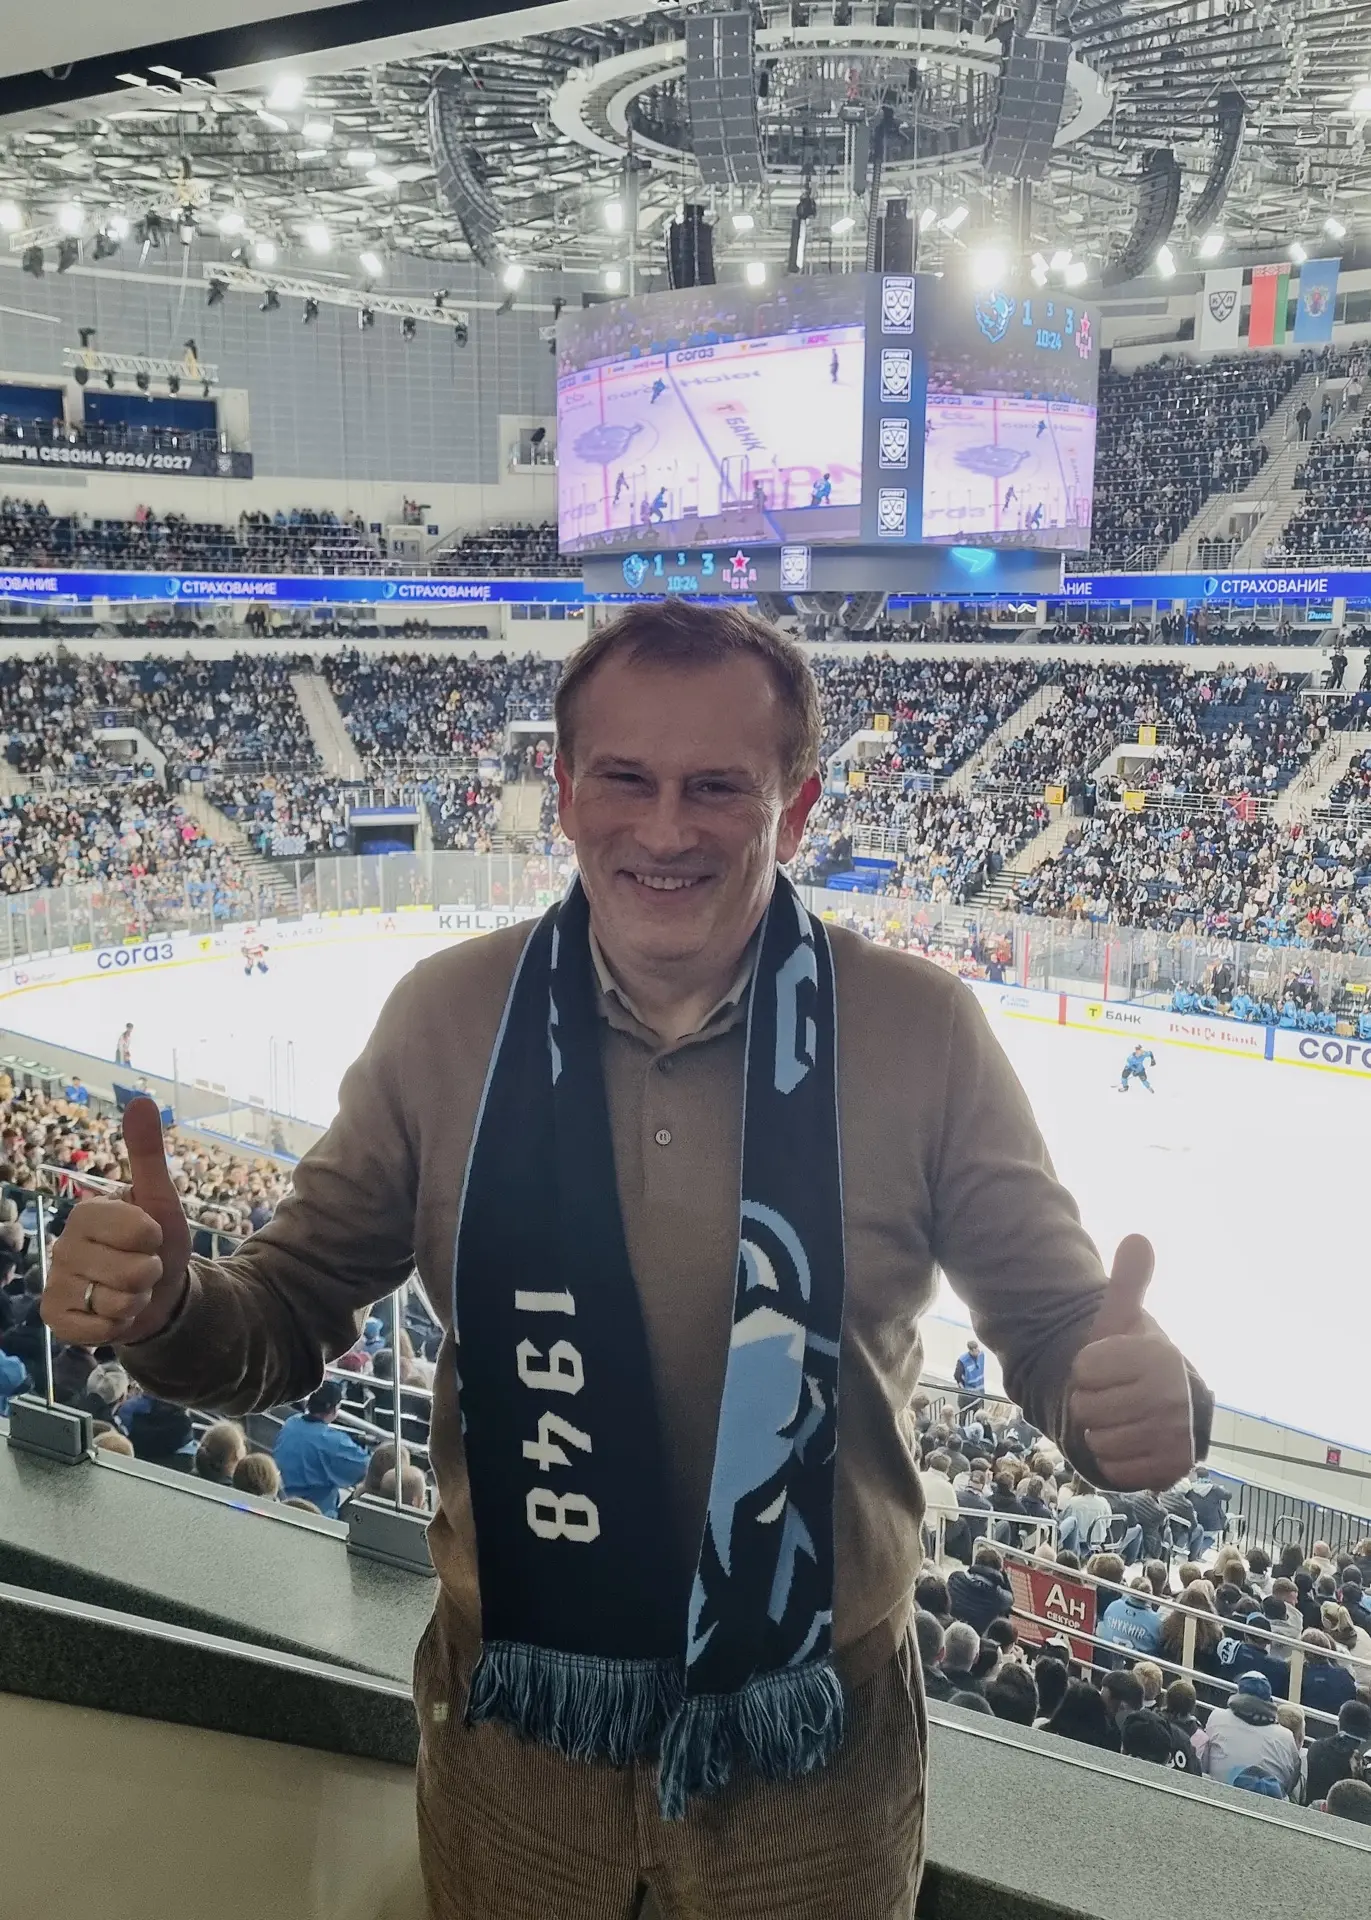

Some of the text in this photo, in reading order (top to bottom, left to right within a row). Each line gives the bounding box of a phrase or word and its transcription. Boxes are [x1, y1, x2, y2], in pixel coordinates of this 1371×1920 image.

[1022, 299, 1033, 326] 1
[1065, 307, 1075, 335] 3
[40, 446, 103, 465] СЕЗОНА
[105, 451, 192, 470] 2026/2027
[653, 552, 714, 576] 1 3 3
[0, 577, 57, 592] ОВАНИЕ
[182, 579, 277, 595] СТРАХОВАНИЕ
[399, 584, 491, 599] СТРАХОВАНИЕ
[667, 576, 698, 591] 10:24
[1221, 578, 1328, 594] СТРАХОВАНИЕ
[97, 943, 174, 969] согаз
[1106, 1010, 1142, 1025] БАНК
[515, 1288, 600, 1544] 1948
